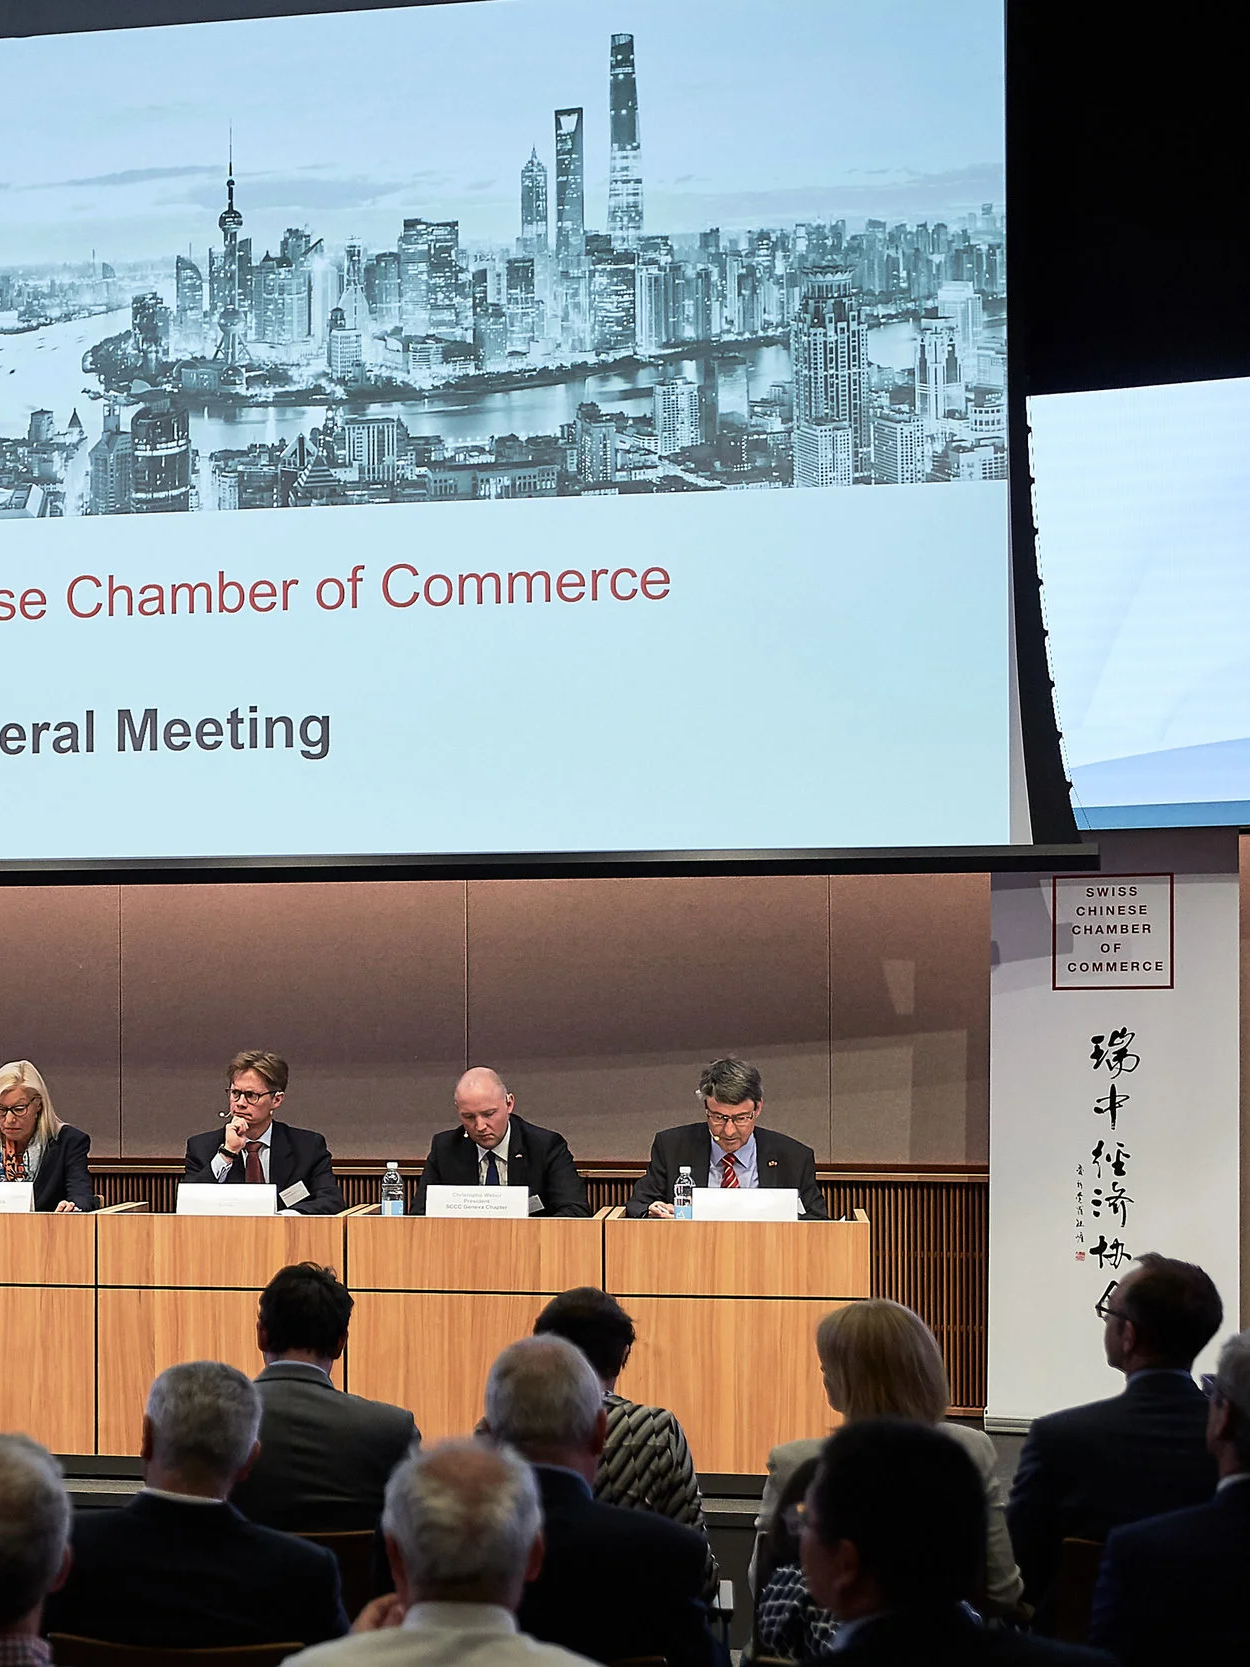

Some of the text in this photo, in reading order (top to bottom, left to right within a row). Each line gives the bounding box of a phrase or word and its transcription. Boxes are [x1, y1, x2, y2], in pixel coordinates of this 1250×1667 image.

[66, 571, 300, 619] Chamber
[317, 564, 366, 611] of
[381, 563, 672, 608] Commerce
[117, 705, 331, 760] Meeting
[1085, 886, 1138, 898] SWISS
[1076, 904, 1148, 917] CHINESE
[1071, 923, 1152, 936] CHAMBER
[1100, 943, 1123, 954] OF
[1067, 961, 1164, 973] COMMERCE
